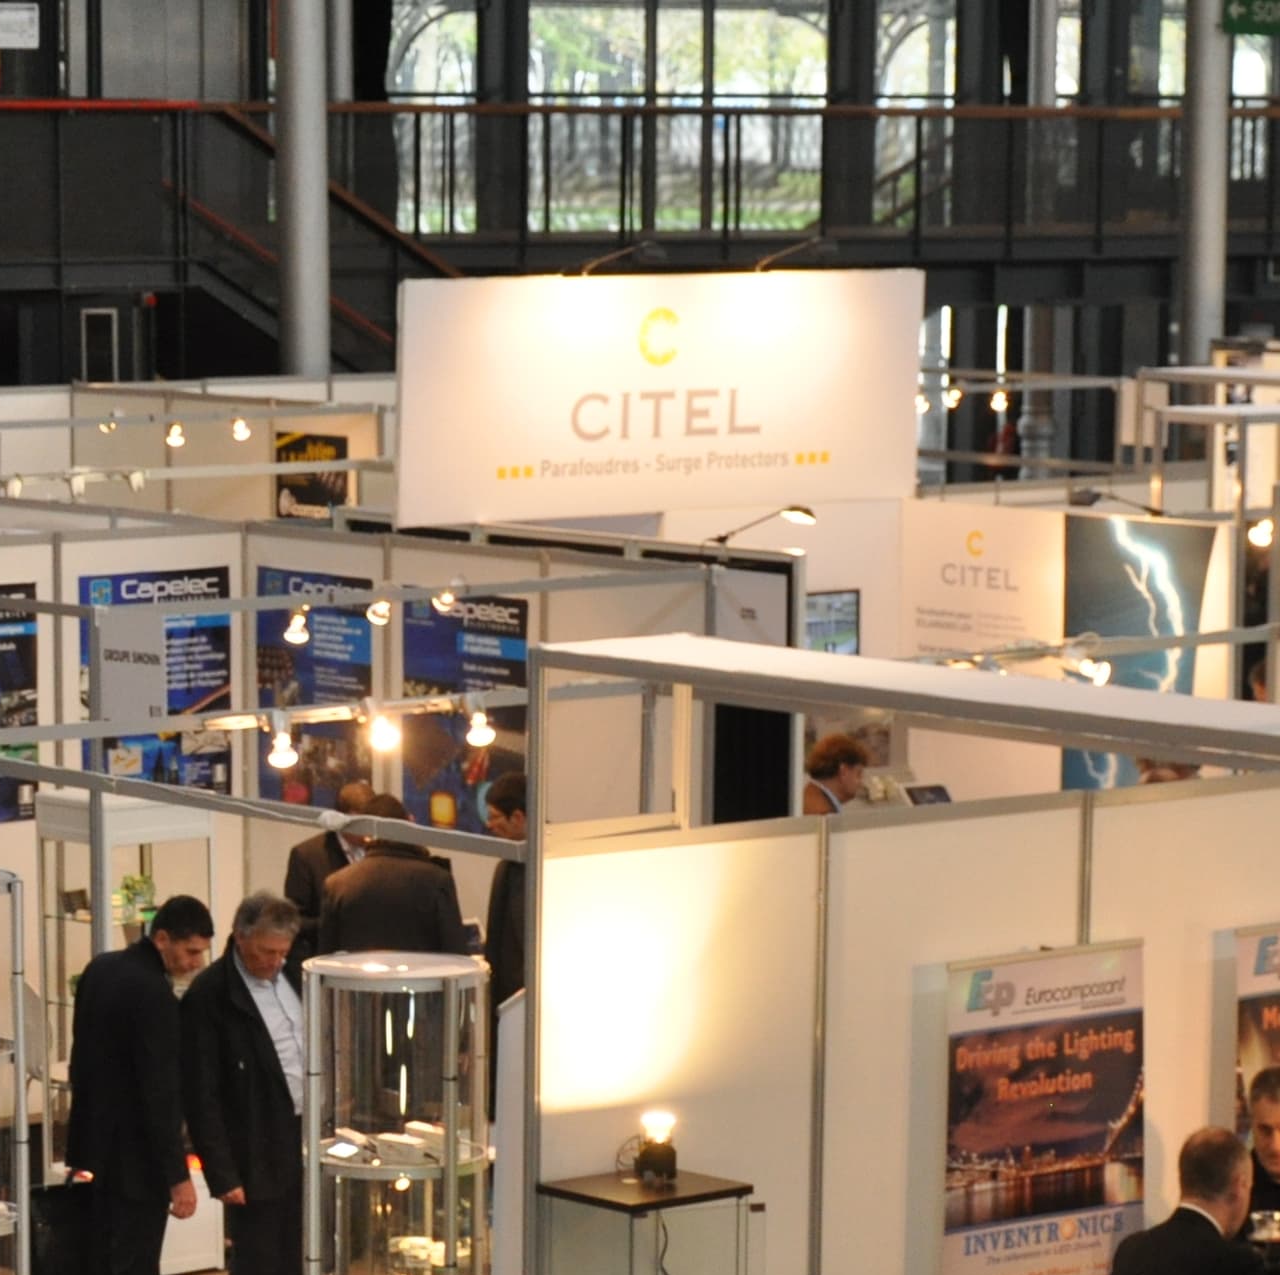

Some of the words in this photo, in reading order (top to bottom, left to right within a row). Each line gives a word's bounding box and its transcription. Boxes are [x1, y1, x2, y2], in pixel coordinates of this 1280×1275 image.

[571, 388, 760, 441] CITEL
[540, 457, 640, 478] Parafoudres
[655, 453, 703, 477] Surge
[707, 448, 790, 470] Protectors
[120, 576, 219, 604] Capelec
[940, 562, 1019, 593] CITEL
[956, 1043, 1021, 1073] Driving
[1026, 1035, 1057, 1062] the
[1063, 1027, 1136, 1059] Lighting
[997, 1070, 1093, 1102] Revolution
